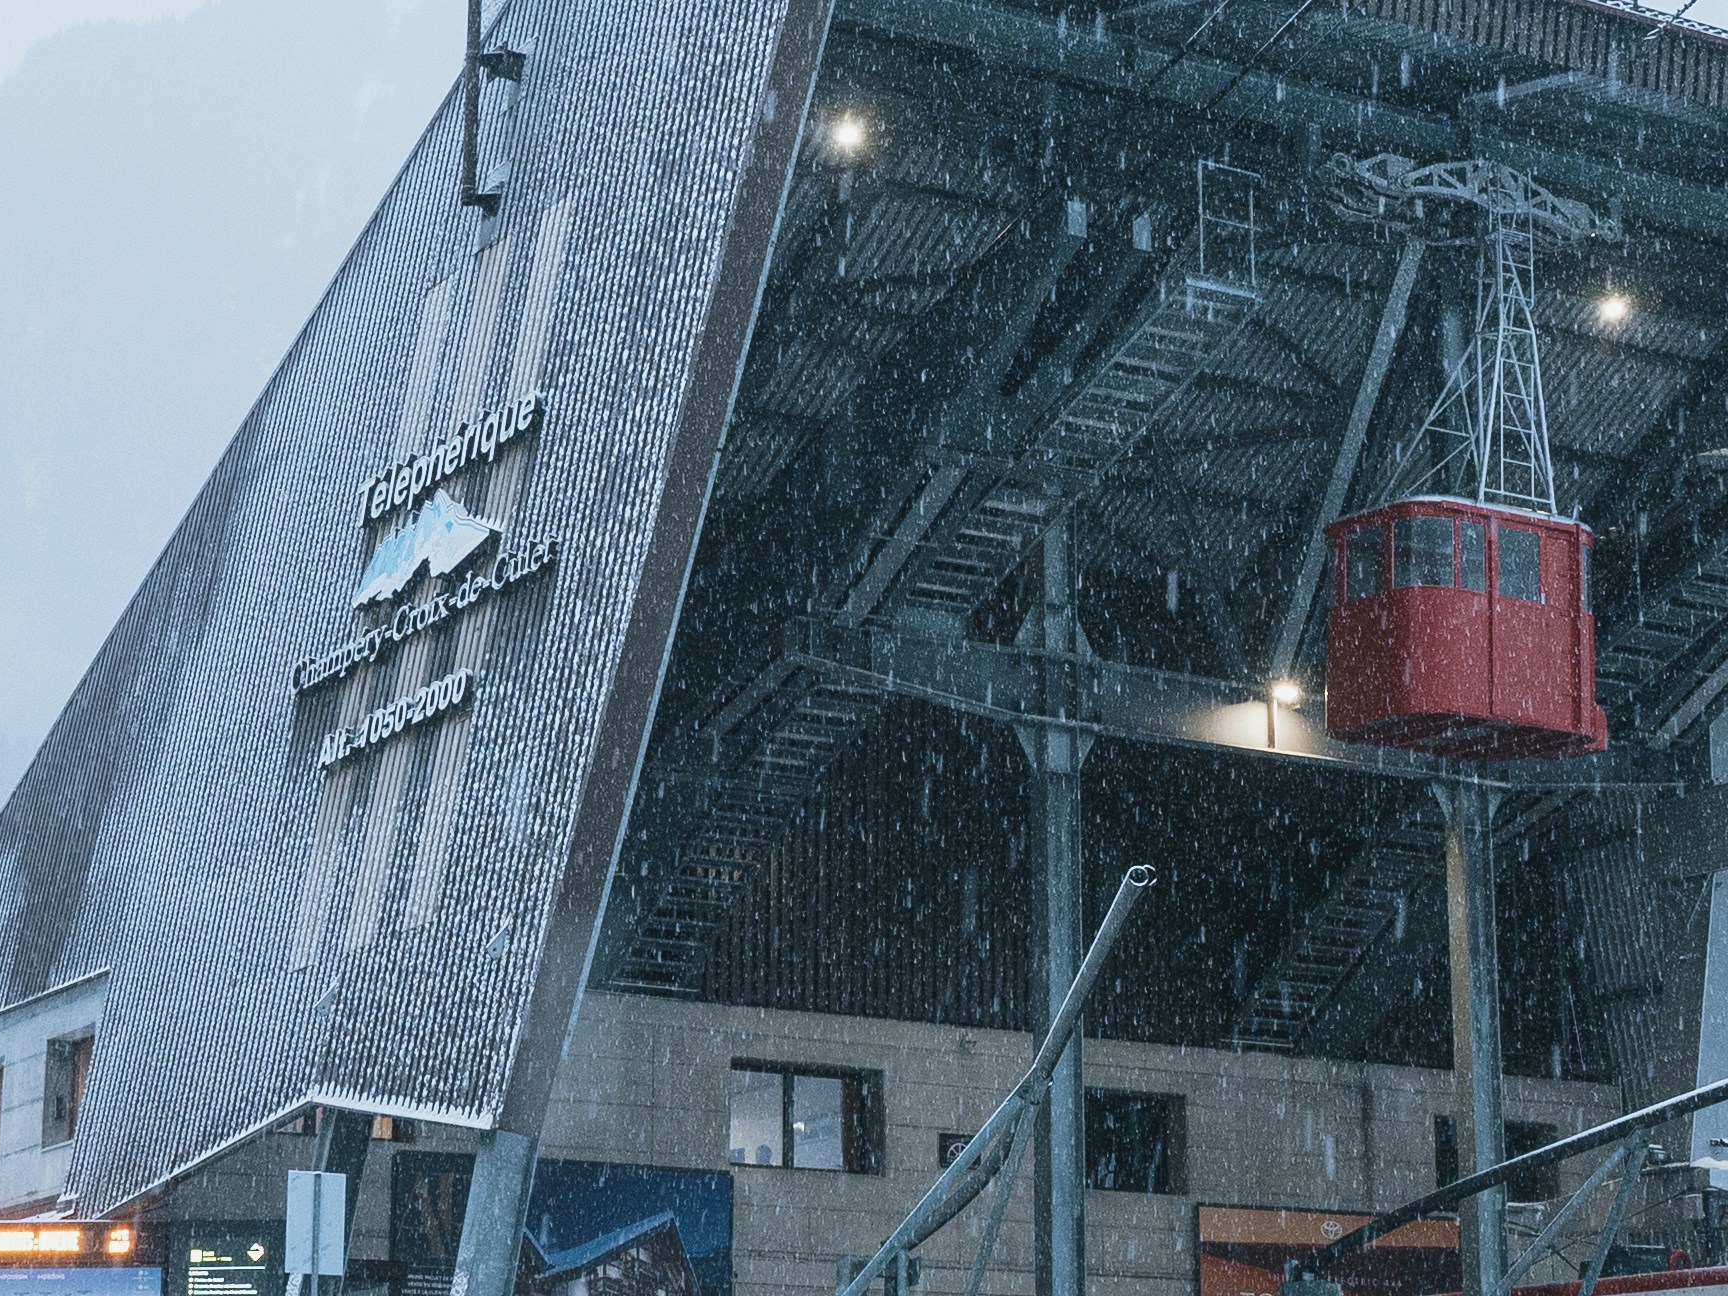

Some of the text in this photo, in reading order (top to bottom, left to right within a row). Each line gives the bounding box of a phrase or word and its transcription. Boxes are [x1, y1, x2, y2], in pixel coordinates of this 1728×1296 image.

[358, 391, 538, 526] Téléphérique
[290, 536, 556, 693] Champéry-Croix-de-Culet
[358, 669, 467, 747] 1050-2000
